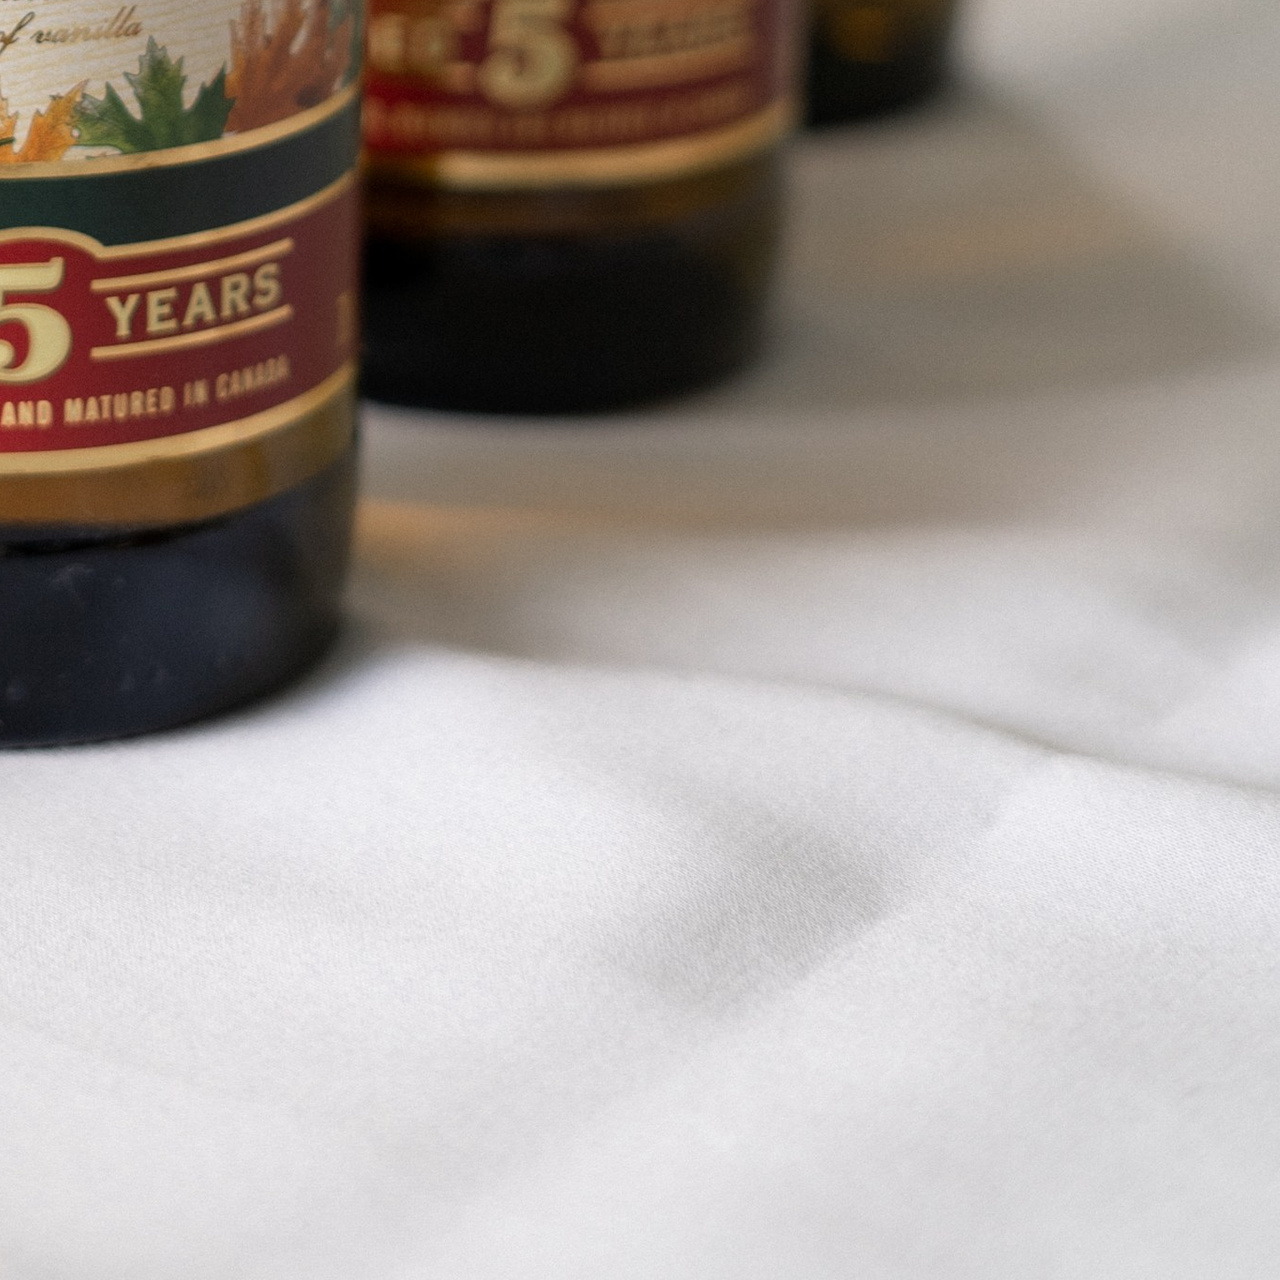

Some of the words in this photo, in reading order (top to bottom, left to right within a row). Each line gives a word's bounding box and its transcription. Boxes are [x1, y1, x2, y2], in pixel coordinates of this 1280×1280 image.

[31, 5, 143, 45] vanilla
[105, 262, 282, 338] YEARS
[0, 399, 53, 430] AND
[63, 385, 176, 425] MATURED
[183, 377, 210, 408] IN
